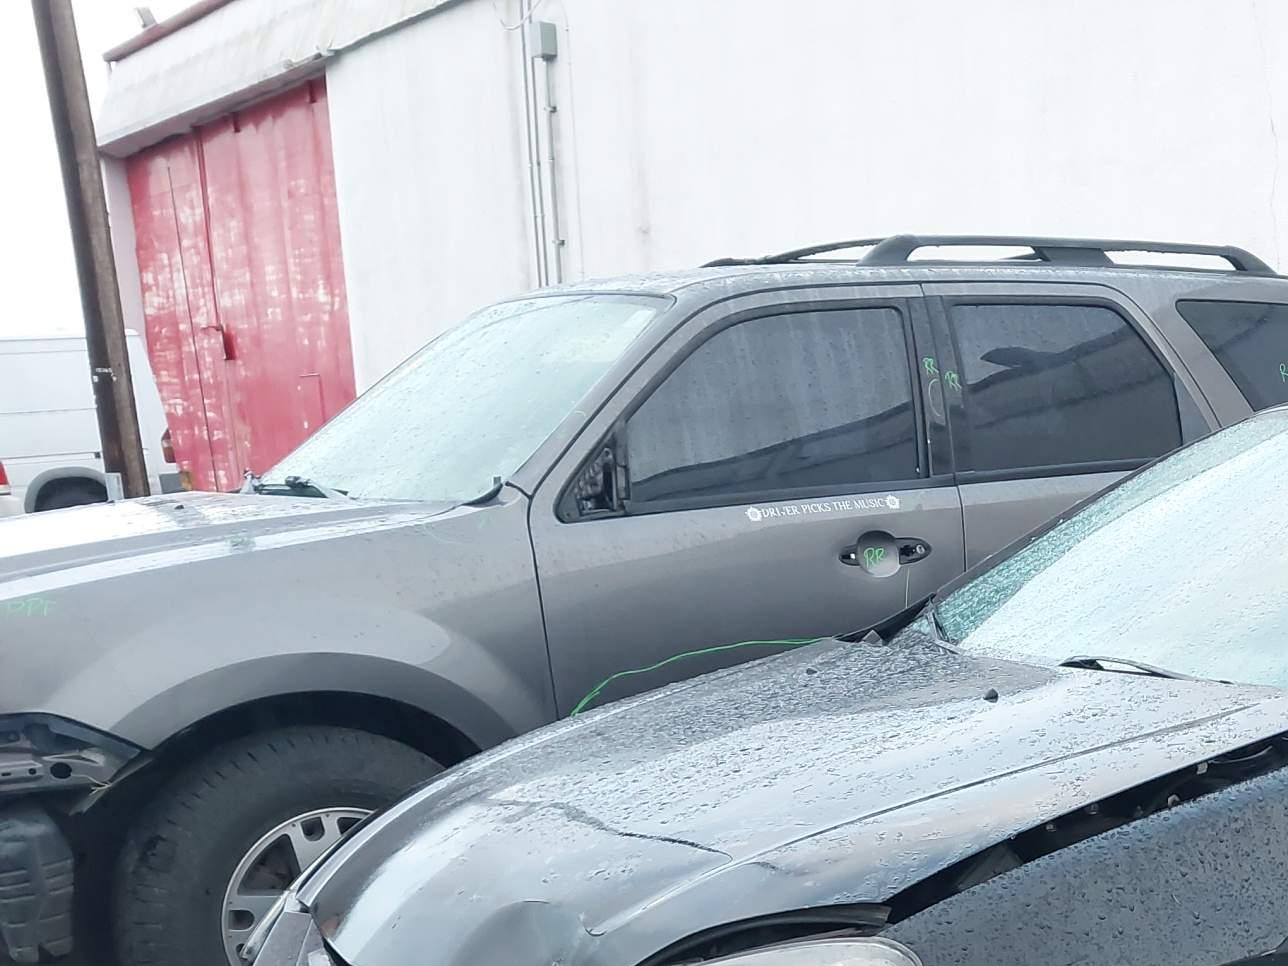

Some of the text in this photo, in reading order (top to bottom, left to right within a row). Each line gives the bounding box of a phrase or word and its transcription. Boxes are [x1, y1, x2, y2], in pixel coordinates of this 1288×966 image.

[802, 502, 831, 513] PICKS
[833, 500, 852, 511] THE
[854, 498, 884, 510] MUSIC
